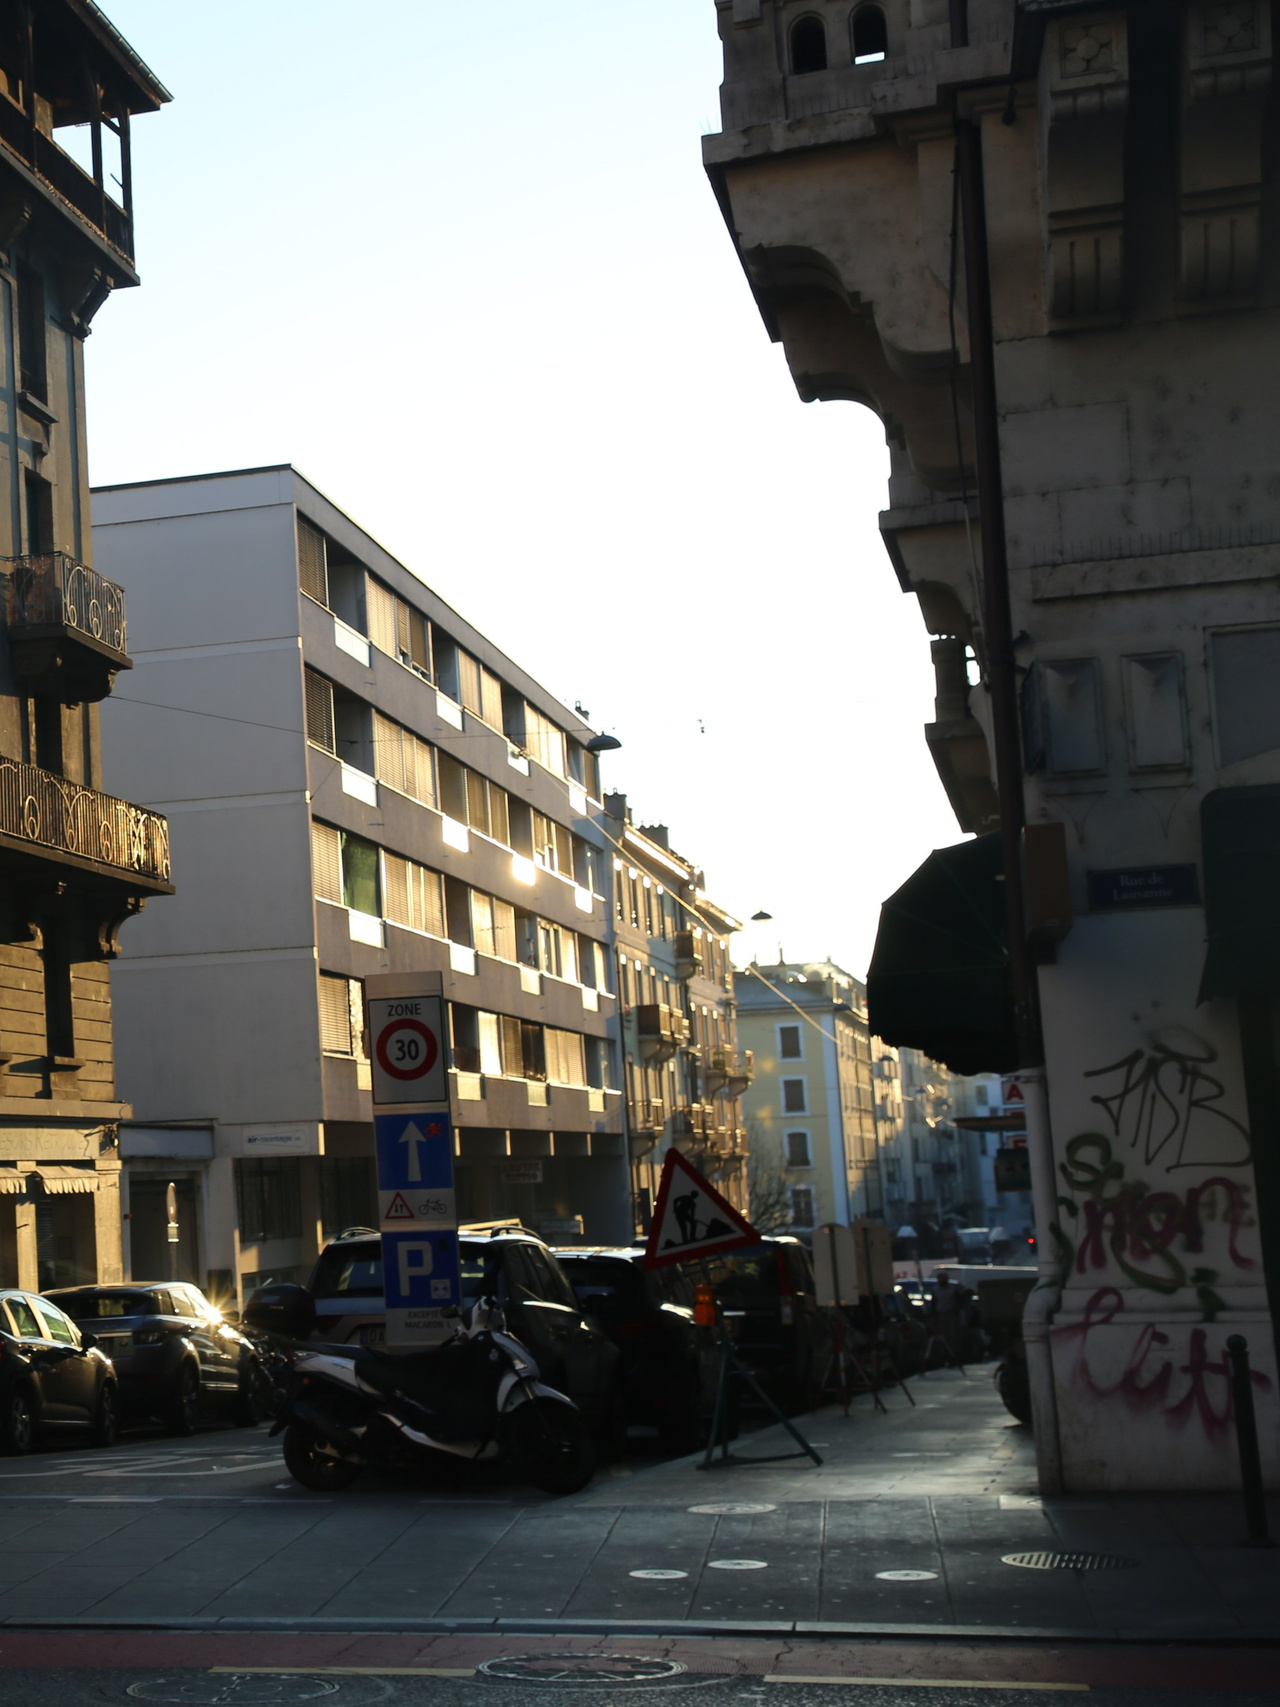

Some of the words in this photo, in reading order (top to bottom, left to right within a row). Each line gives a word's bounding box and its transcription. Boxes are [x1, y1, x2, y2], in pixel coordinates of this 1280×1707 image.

[1119, 874, 1145, 887] Rue
[1148, 872, 1165, 885] de
[1112, 888, 1174, 901] Lausanne
[387, 1003, 422, 1017] ZONE
[395, 1039, 419, 1061] 30
[397, 1241, 434, 1297] P
[405, 1320, 444, 1329] MACARON
[369, 1329, 385, 1343] DA
